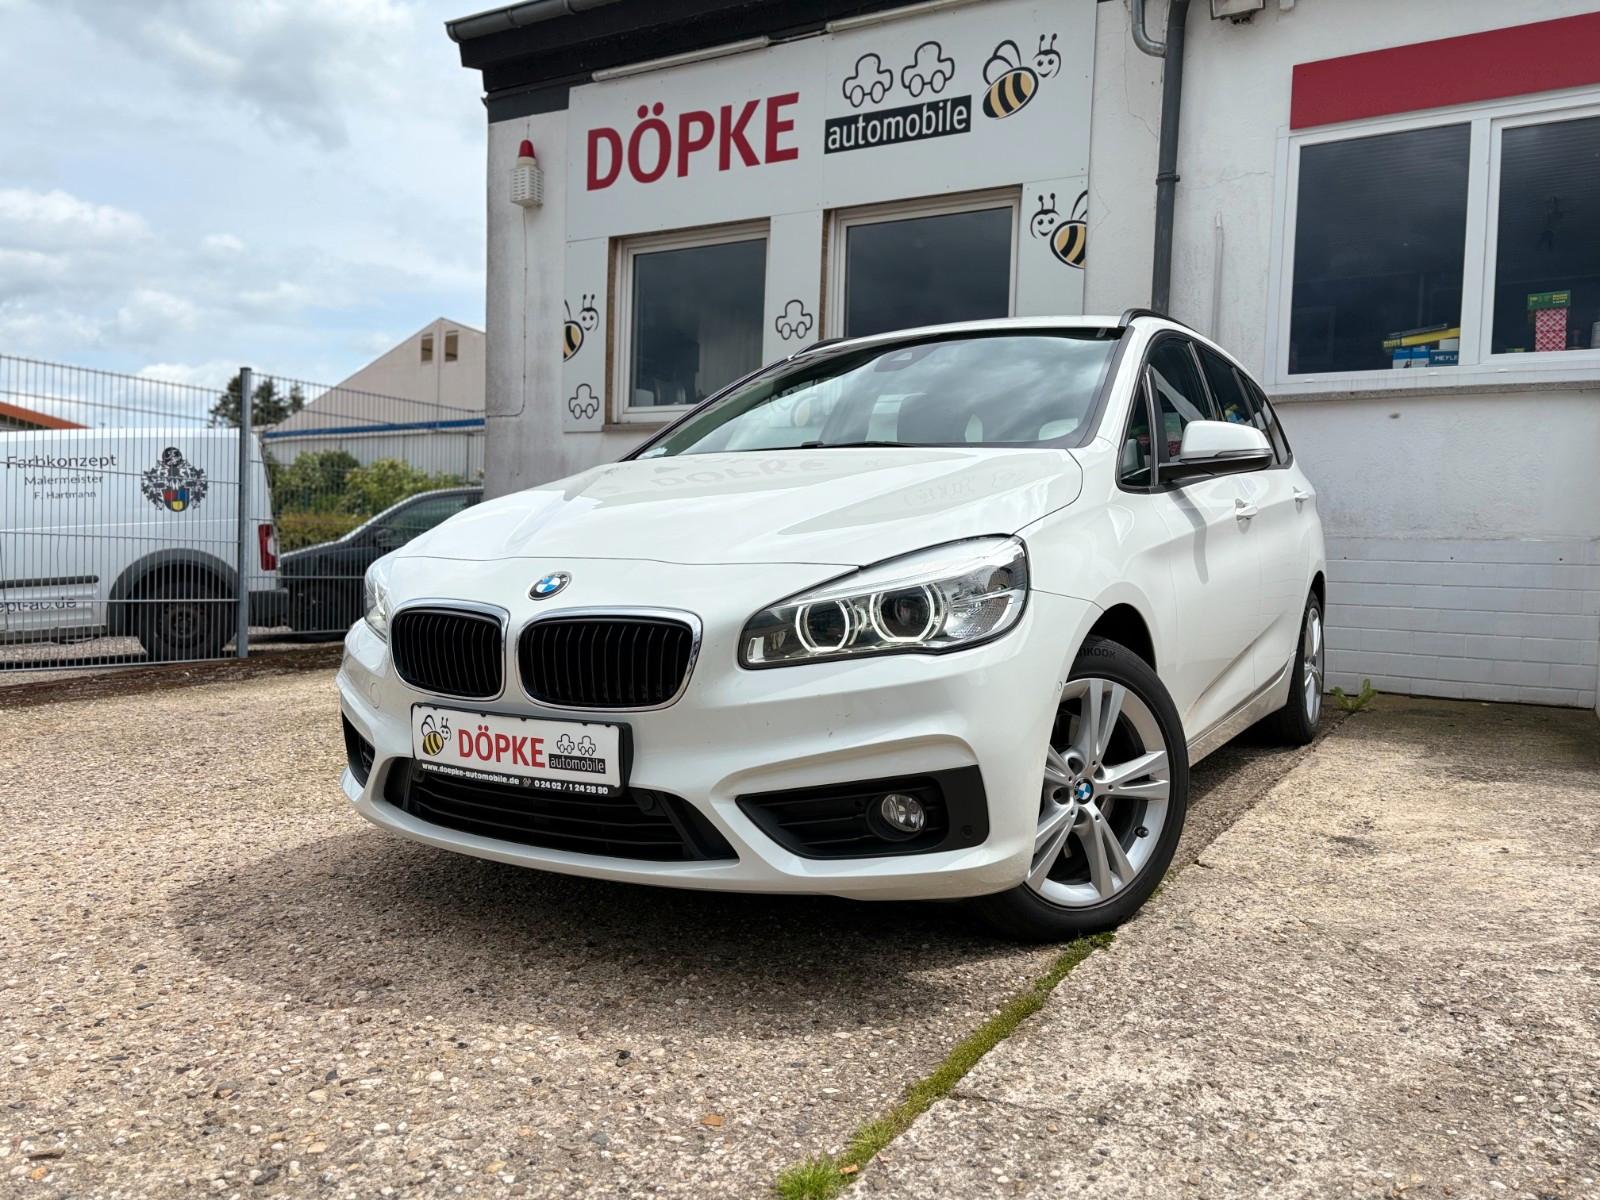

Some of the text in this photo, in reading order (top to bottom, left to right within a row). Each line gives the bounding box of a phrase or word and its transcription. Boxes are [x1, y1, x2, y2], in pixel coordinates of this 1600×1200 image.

[827, 101, 968, 150] automobile
[586, 91, 800, 191] DÖPKE
[7, 454, 117, 469] Farbkonzept
[25, 475, 103, 486] Malermeister
[46, 490, 97, 500] Hartmann
[458, 724, 546, 768] DÖPKE
[422, 762, 520, 785] www.doepke-automobile.de
[550, 756, 605, 773] automobile
